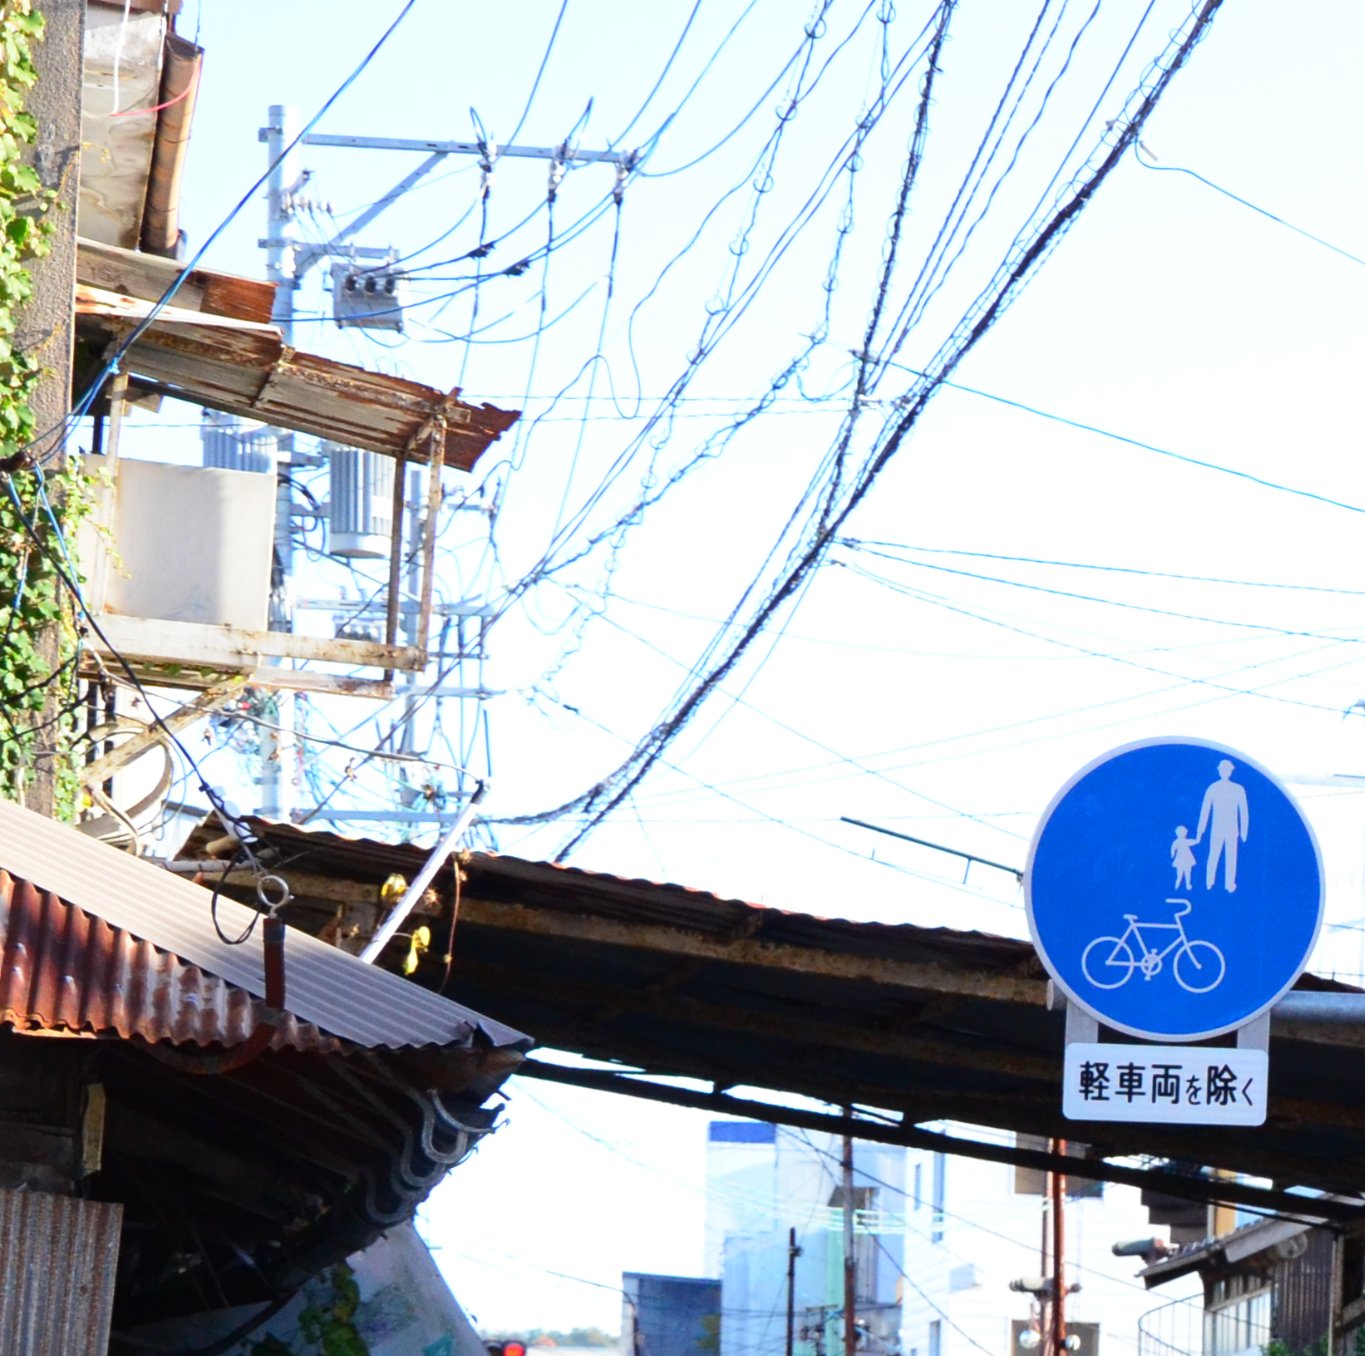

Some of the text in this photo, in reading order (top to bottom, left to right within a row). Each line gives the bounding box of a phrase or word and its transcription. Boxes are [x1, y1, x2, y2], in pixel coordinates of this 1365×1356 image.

[1078, 1060, 1254, 1107] 軽車両を除く
